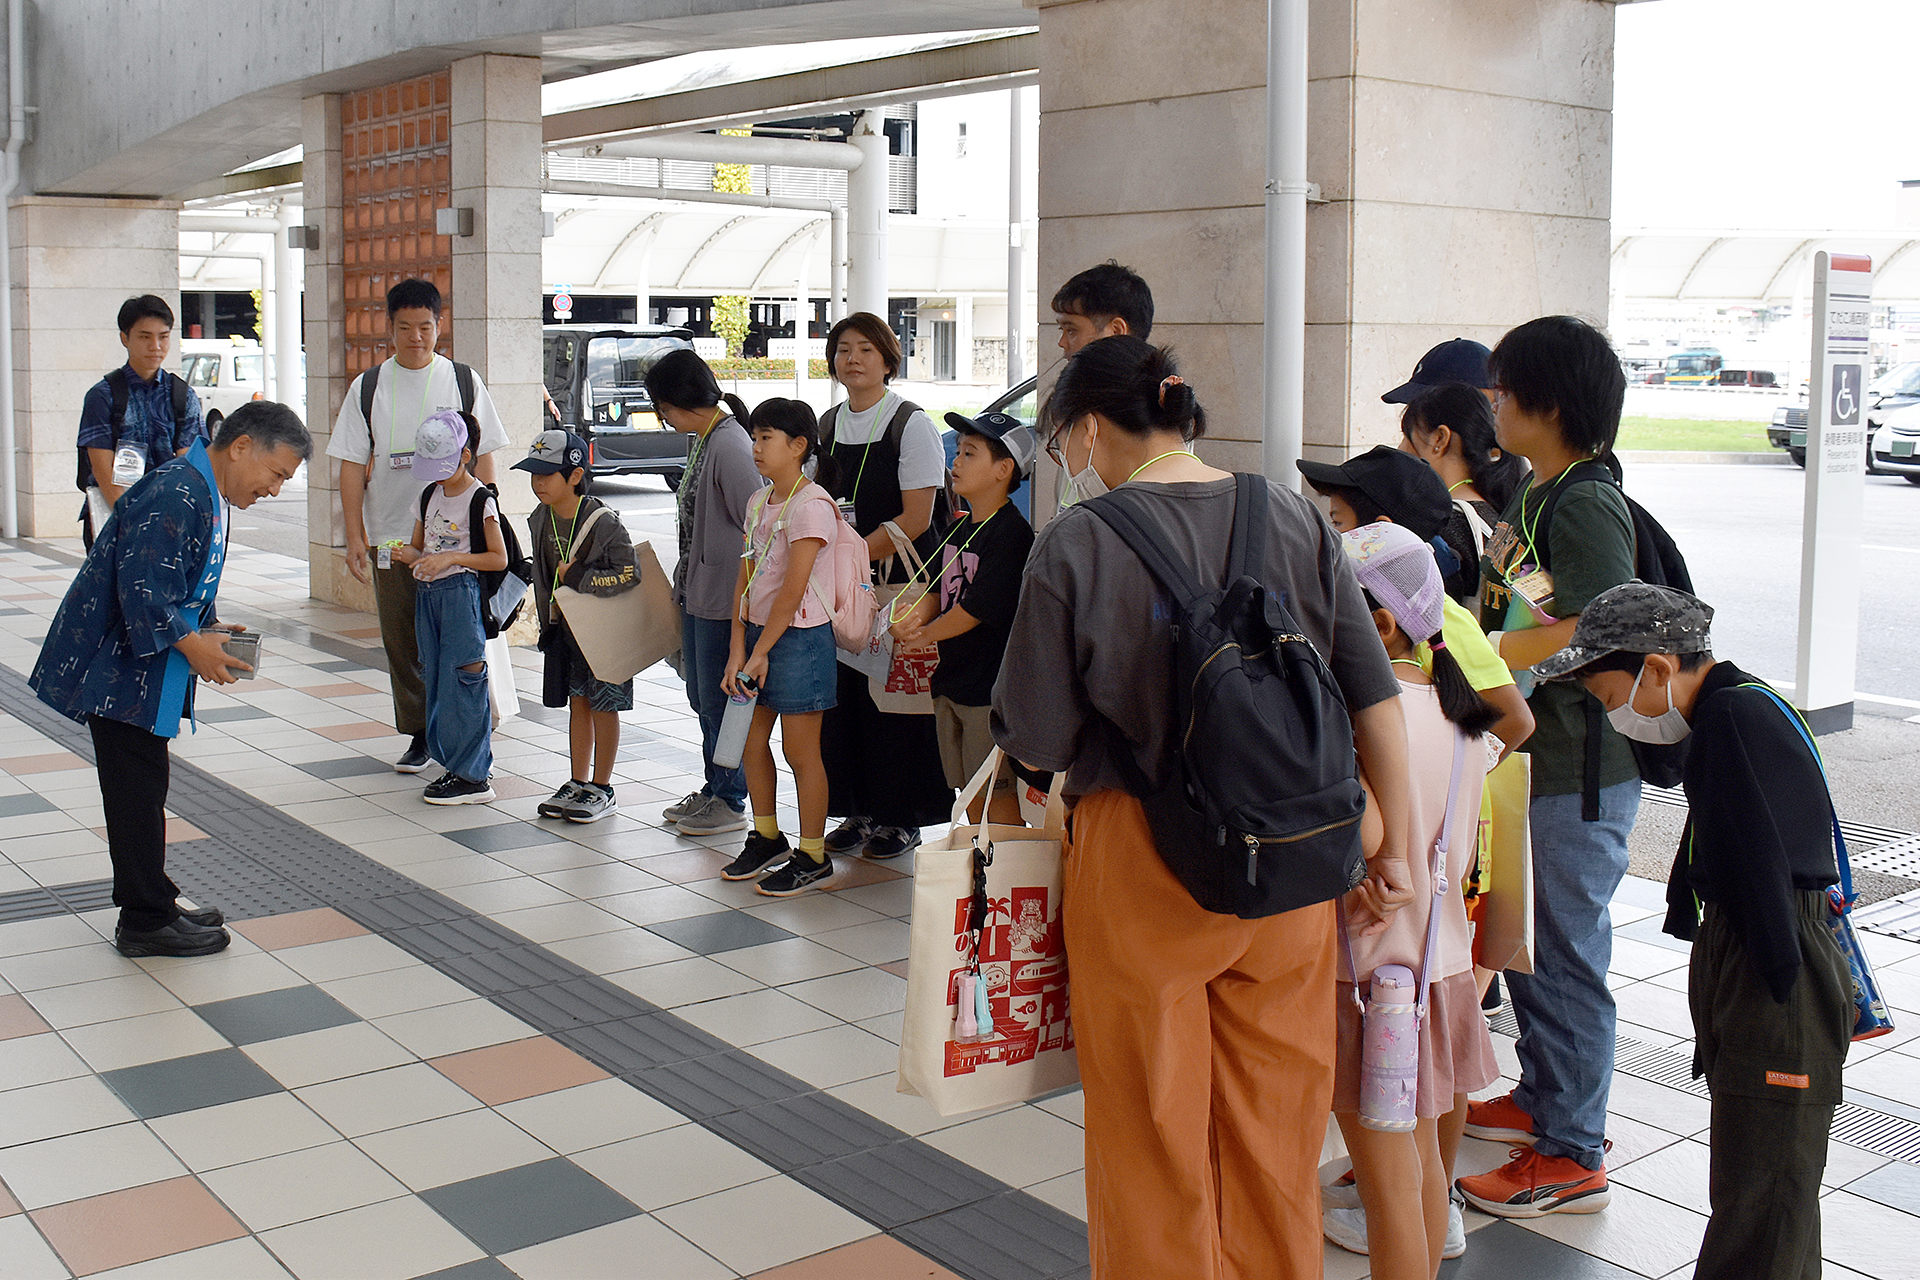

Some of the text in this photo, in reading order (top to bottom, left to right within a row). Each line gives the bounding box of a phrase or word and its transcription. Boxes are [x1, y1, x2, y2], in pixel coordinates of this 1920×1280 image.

[1827, 449, 1851, 460] Reserved
[1827, 462, 1859, 474] disabled only
